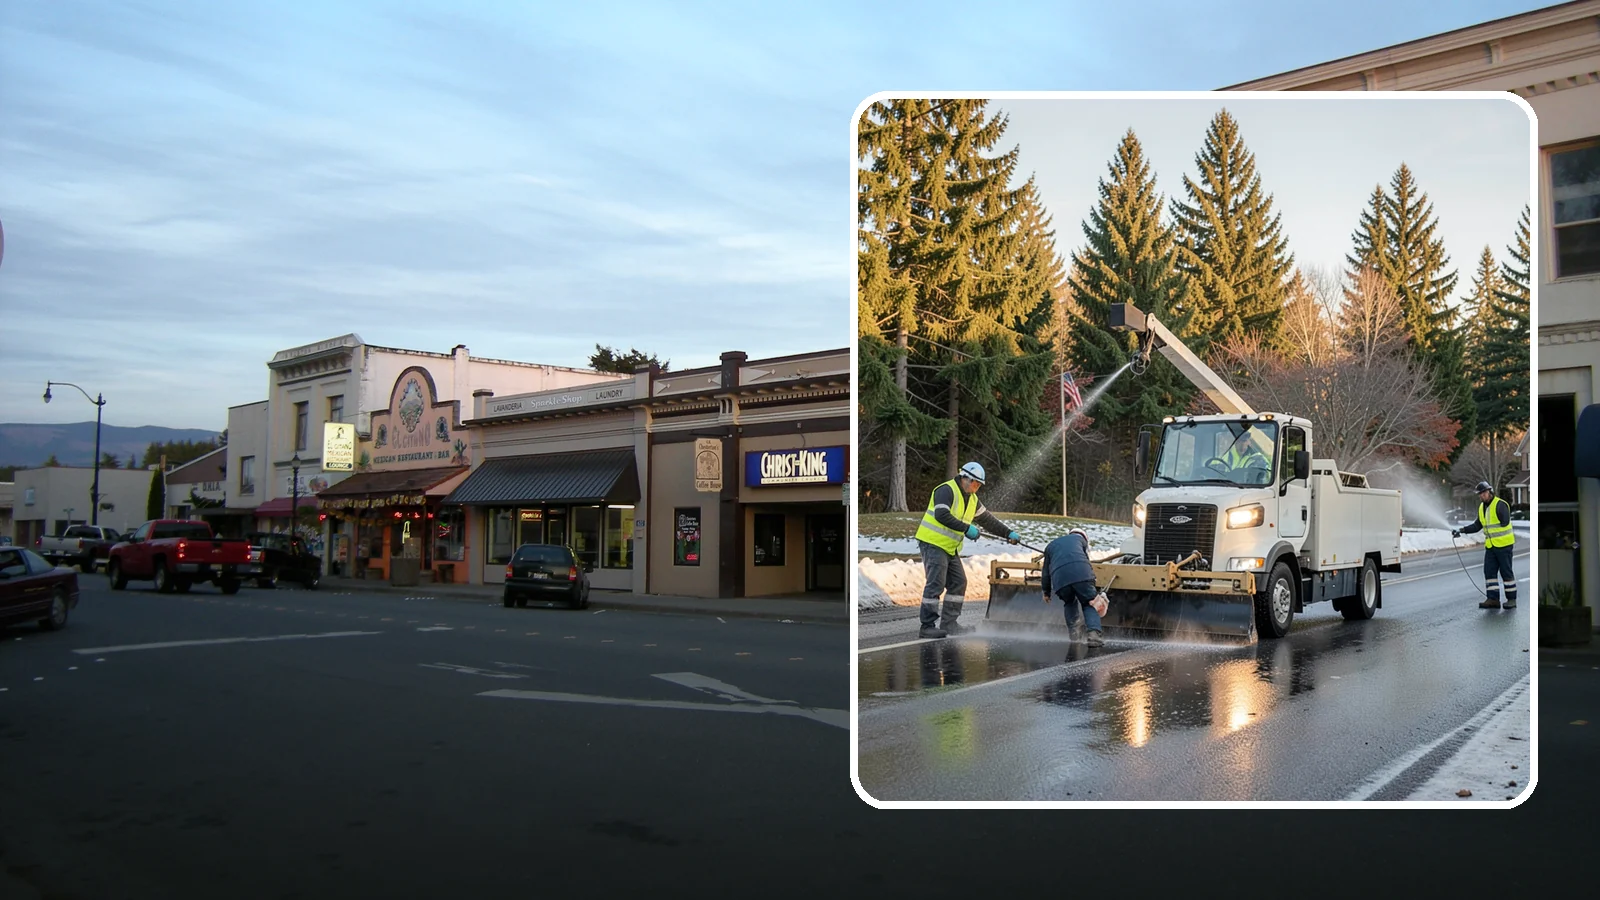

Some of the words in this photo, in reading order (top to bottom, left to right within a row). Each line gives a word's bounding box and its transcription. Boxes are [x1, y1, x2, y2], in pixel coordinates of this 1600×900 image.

[493, 402, 522, 412] LAVANDERIA
[531, 397, 561, 408] Sparkle
[562, 394, 582, 404] Shop
[596, 389, 623, 400] LAUNDRY
[373, 455, 396, 464] MEXICAN
[397, 451, 433, 462] RESTAURANT
[438, 450, 450, 458] BAR
[799, 450, 827, 476] KING
[696, 480, 709, 488] Coffee
[710, 480, 722, 488] House
